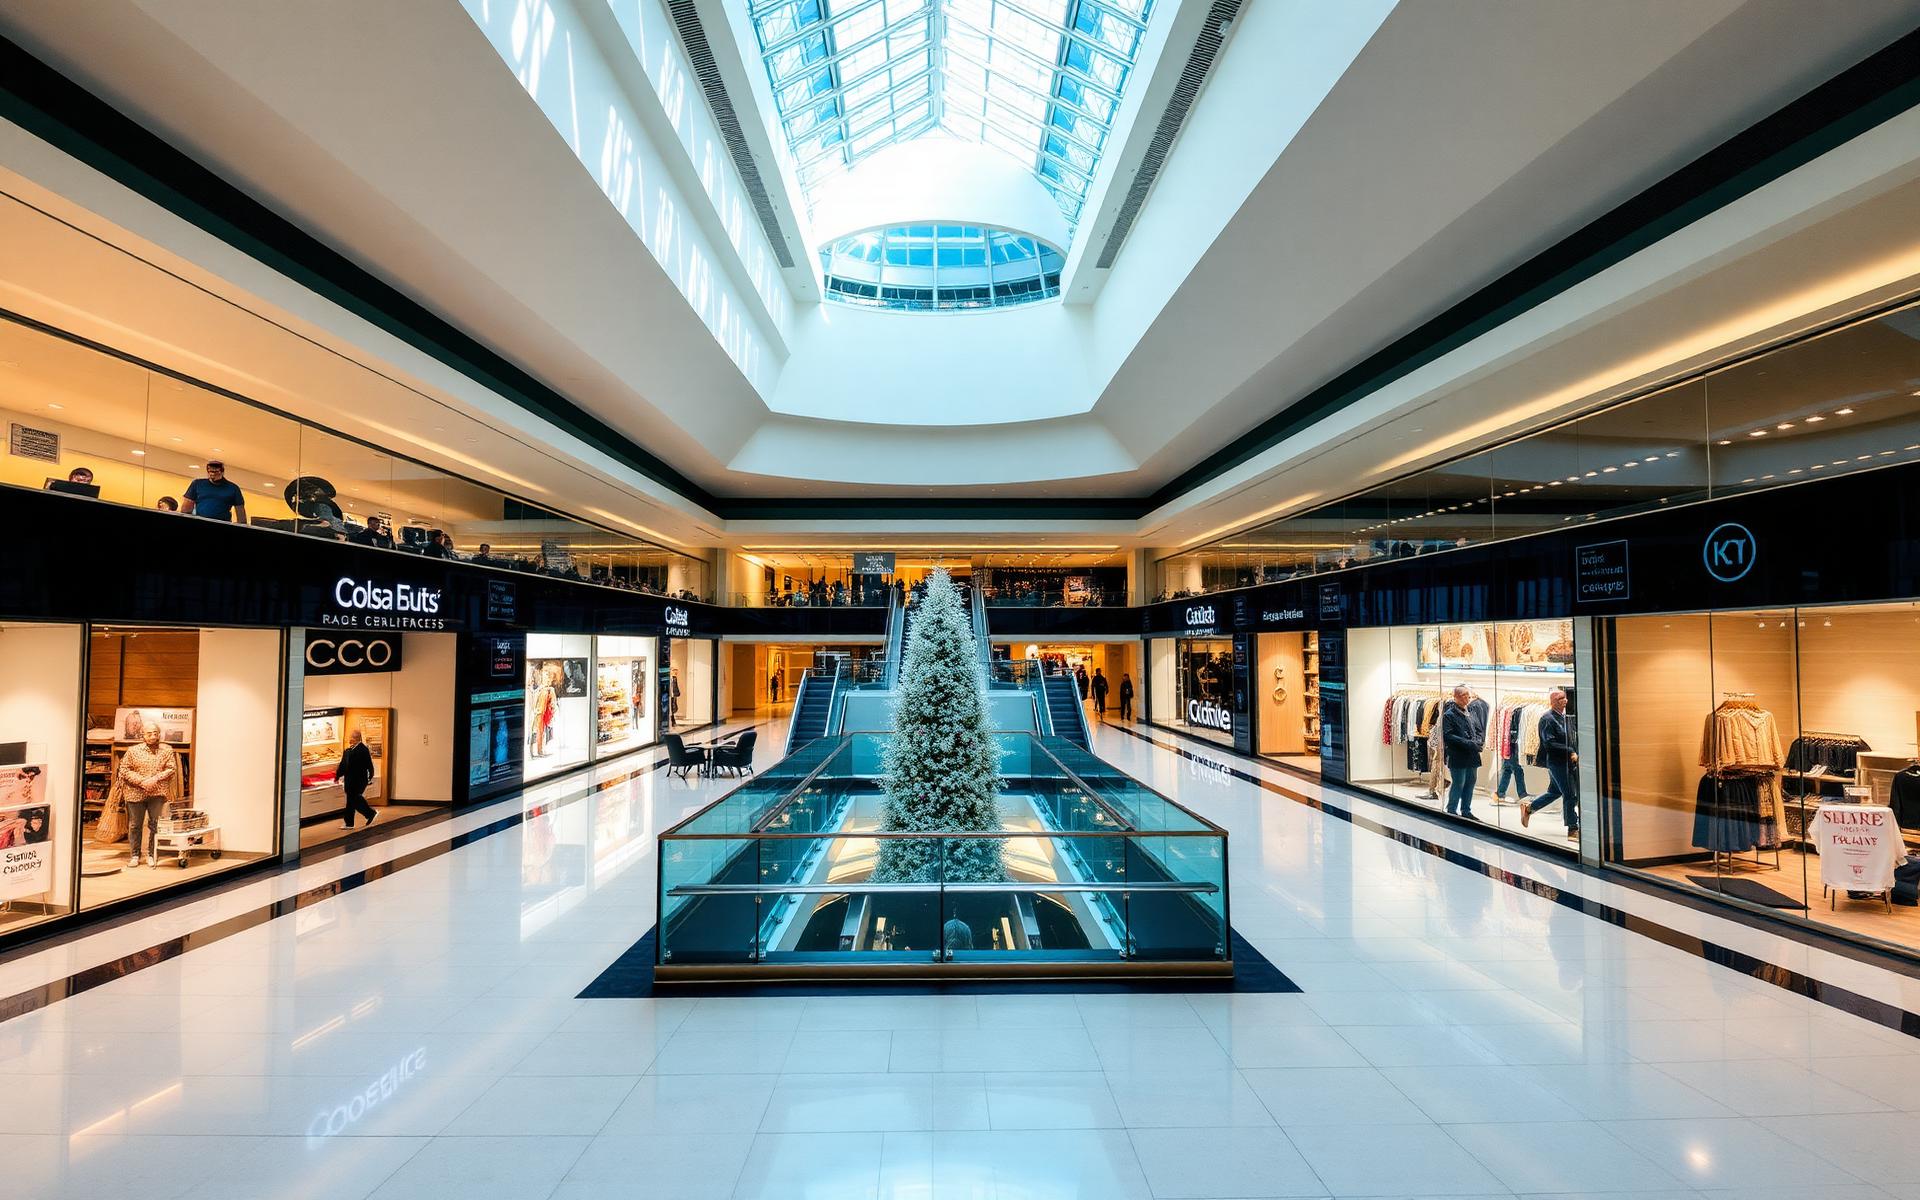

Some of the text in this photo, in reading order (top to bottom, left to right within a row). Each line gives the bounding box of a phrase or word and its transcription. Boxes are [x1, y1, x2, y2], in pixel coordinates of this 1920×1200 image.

[1713, 538, 1747, 567] KT
[335, 577, 393, 610] Colsa
[305, 639, 392, 668] CCO
